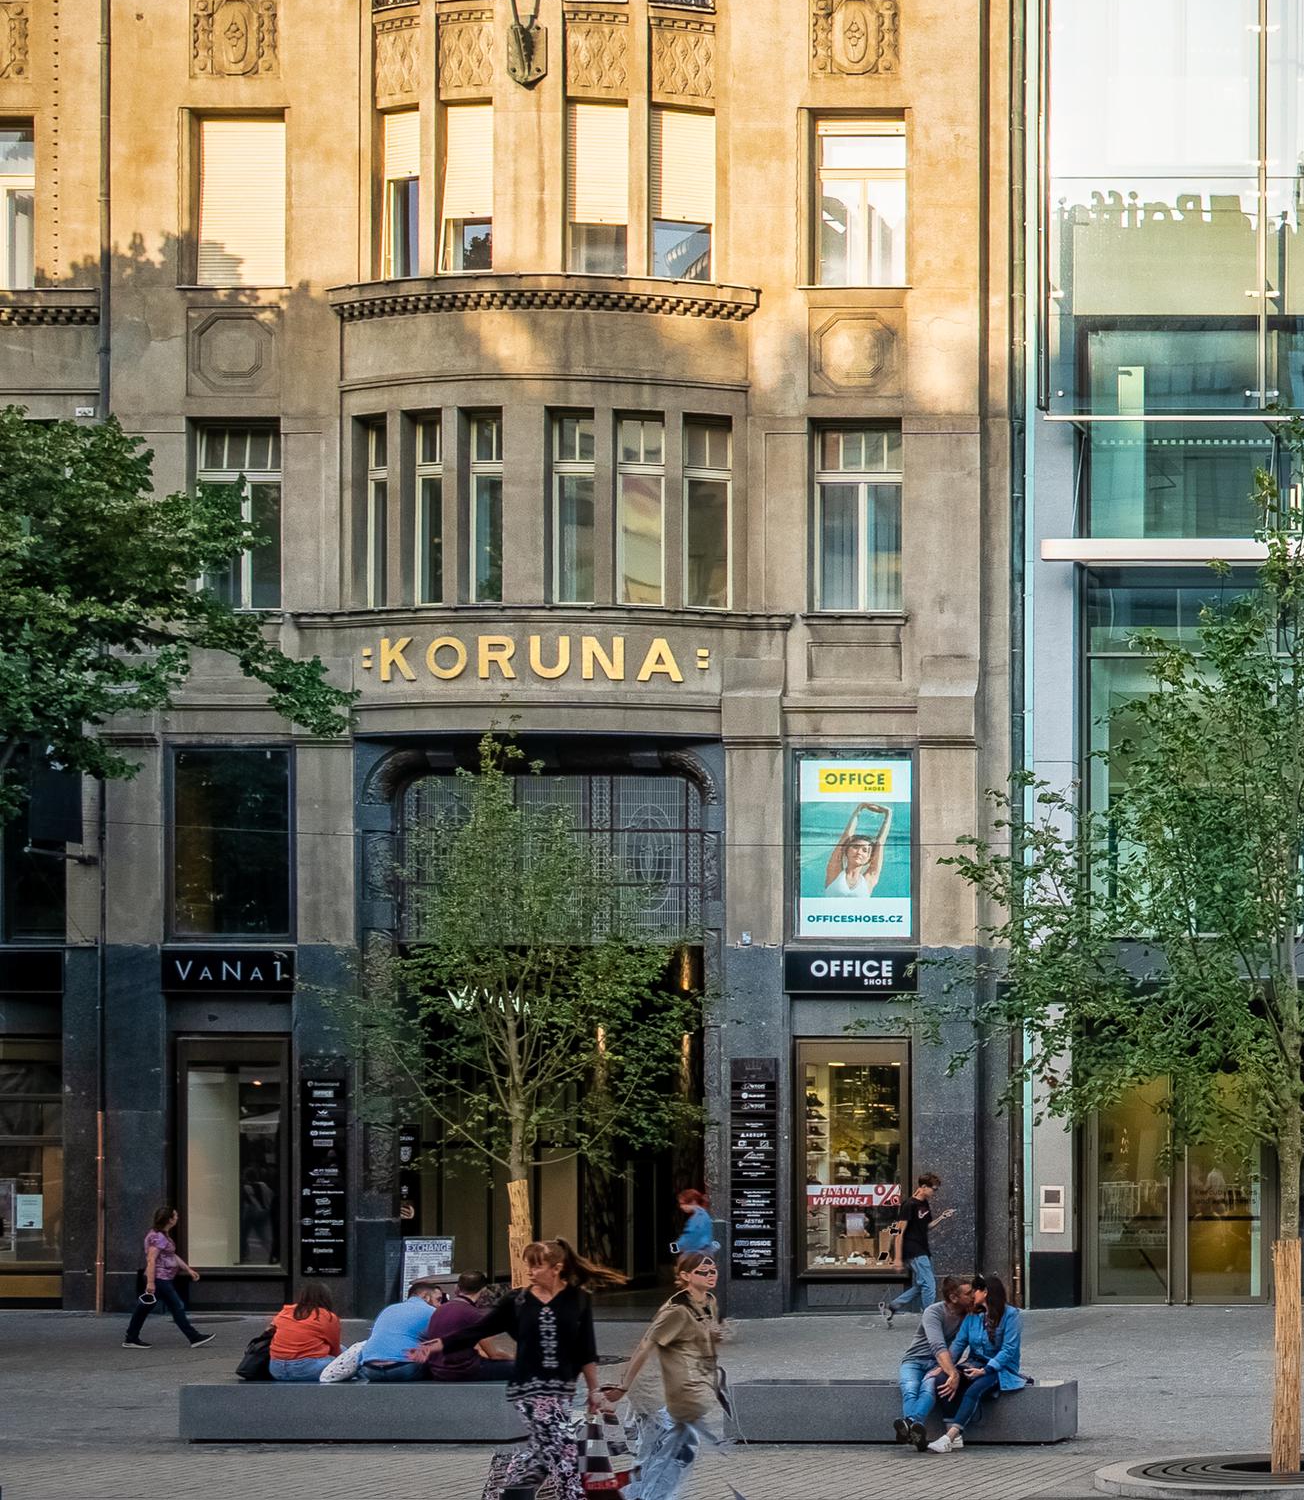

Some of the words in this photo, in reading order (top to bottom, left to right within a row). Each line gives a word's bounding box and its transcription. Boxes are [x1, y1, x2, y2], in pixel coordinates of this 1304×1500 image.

[380, 635, 684, 682] KORUNA
[824, 772, 886, 785] OFFICE
[807, 914, 904, 923] OFFICESHOES.CZ
[810, 959, 893, 978] OFFICE
[863, 978, 893, 986] SHOES
[812, 1194, 869, 1205] VÝPRODEJ
[406, 1243, 453, 1252] EXCHANGE
